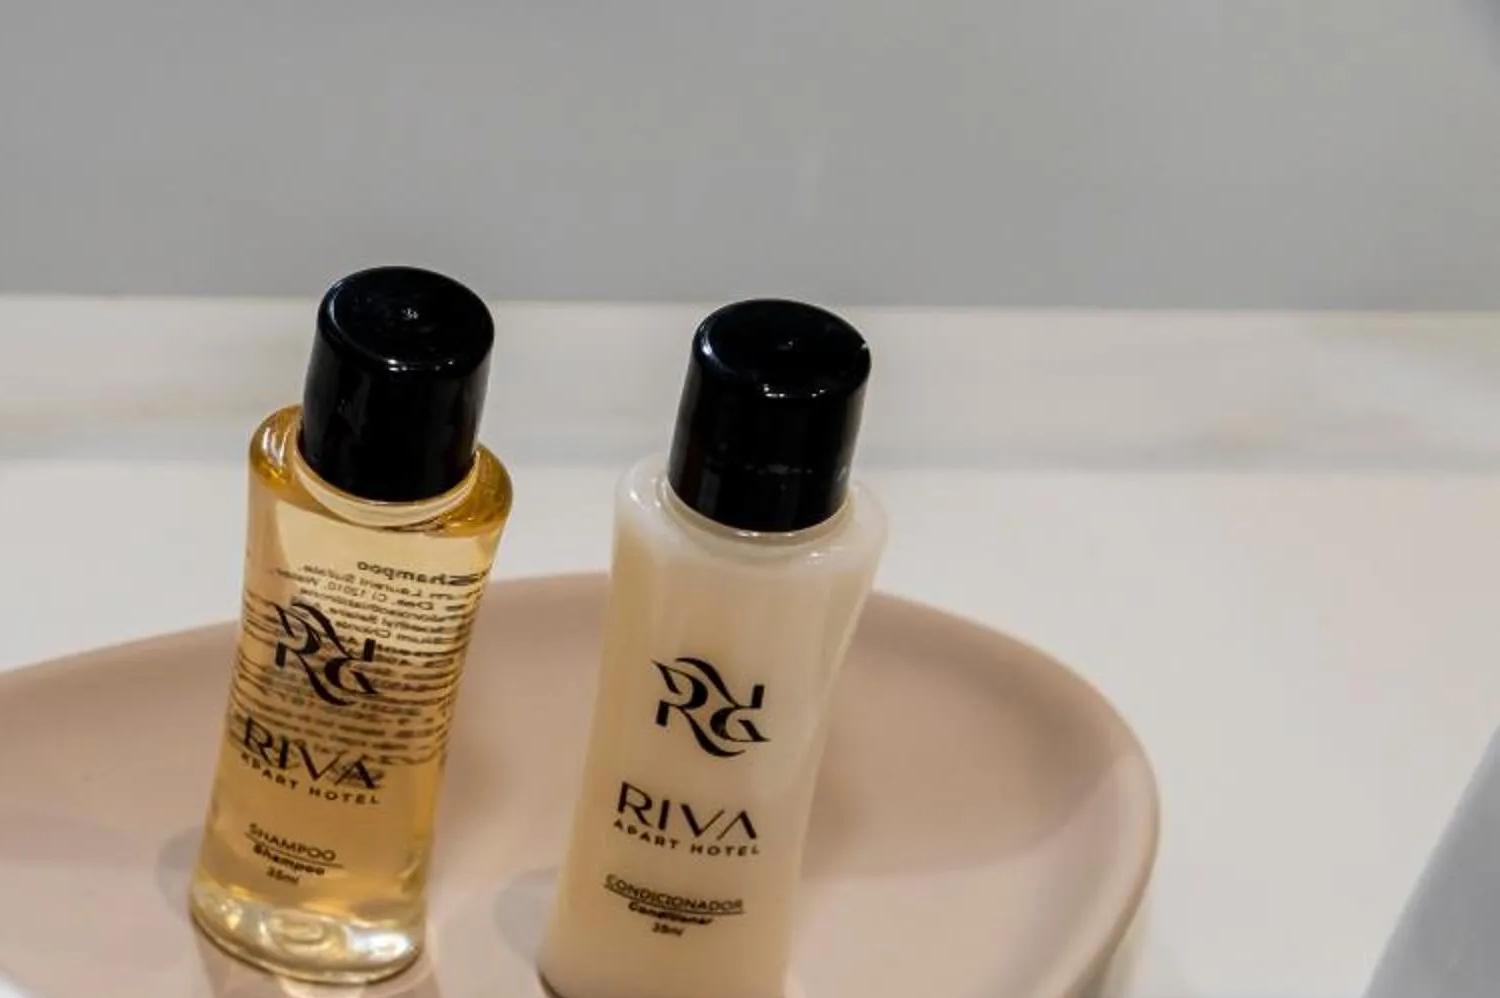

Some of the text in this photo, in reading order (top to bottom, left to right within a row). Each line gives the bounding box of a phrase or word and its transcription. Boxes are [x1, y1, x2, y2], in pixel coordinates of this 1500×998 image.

[244, 716, 375, 789] RIVA
[241, 752, 380, 806] APART HOTEL
[617, 780, 757, 841] RIVA
[249, 822, 336, 862] SHAMPOO
[613, 819, 760, 858] APART HOTEL
[605, 873, 743, 912] CONDICIONADOR
